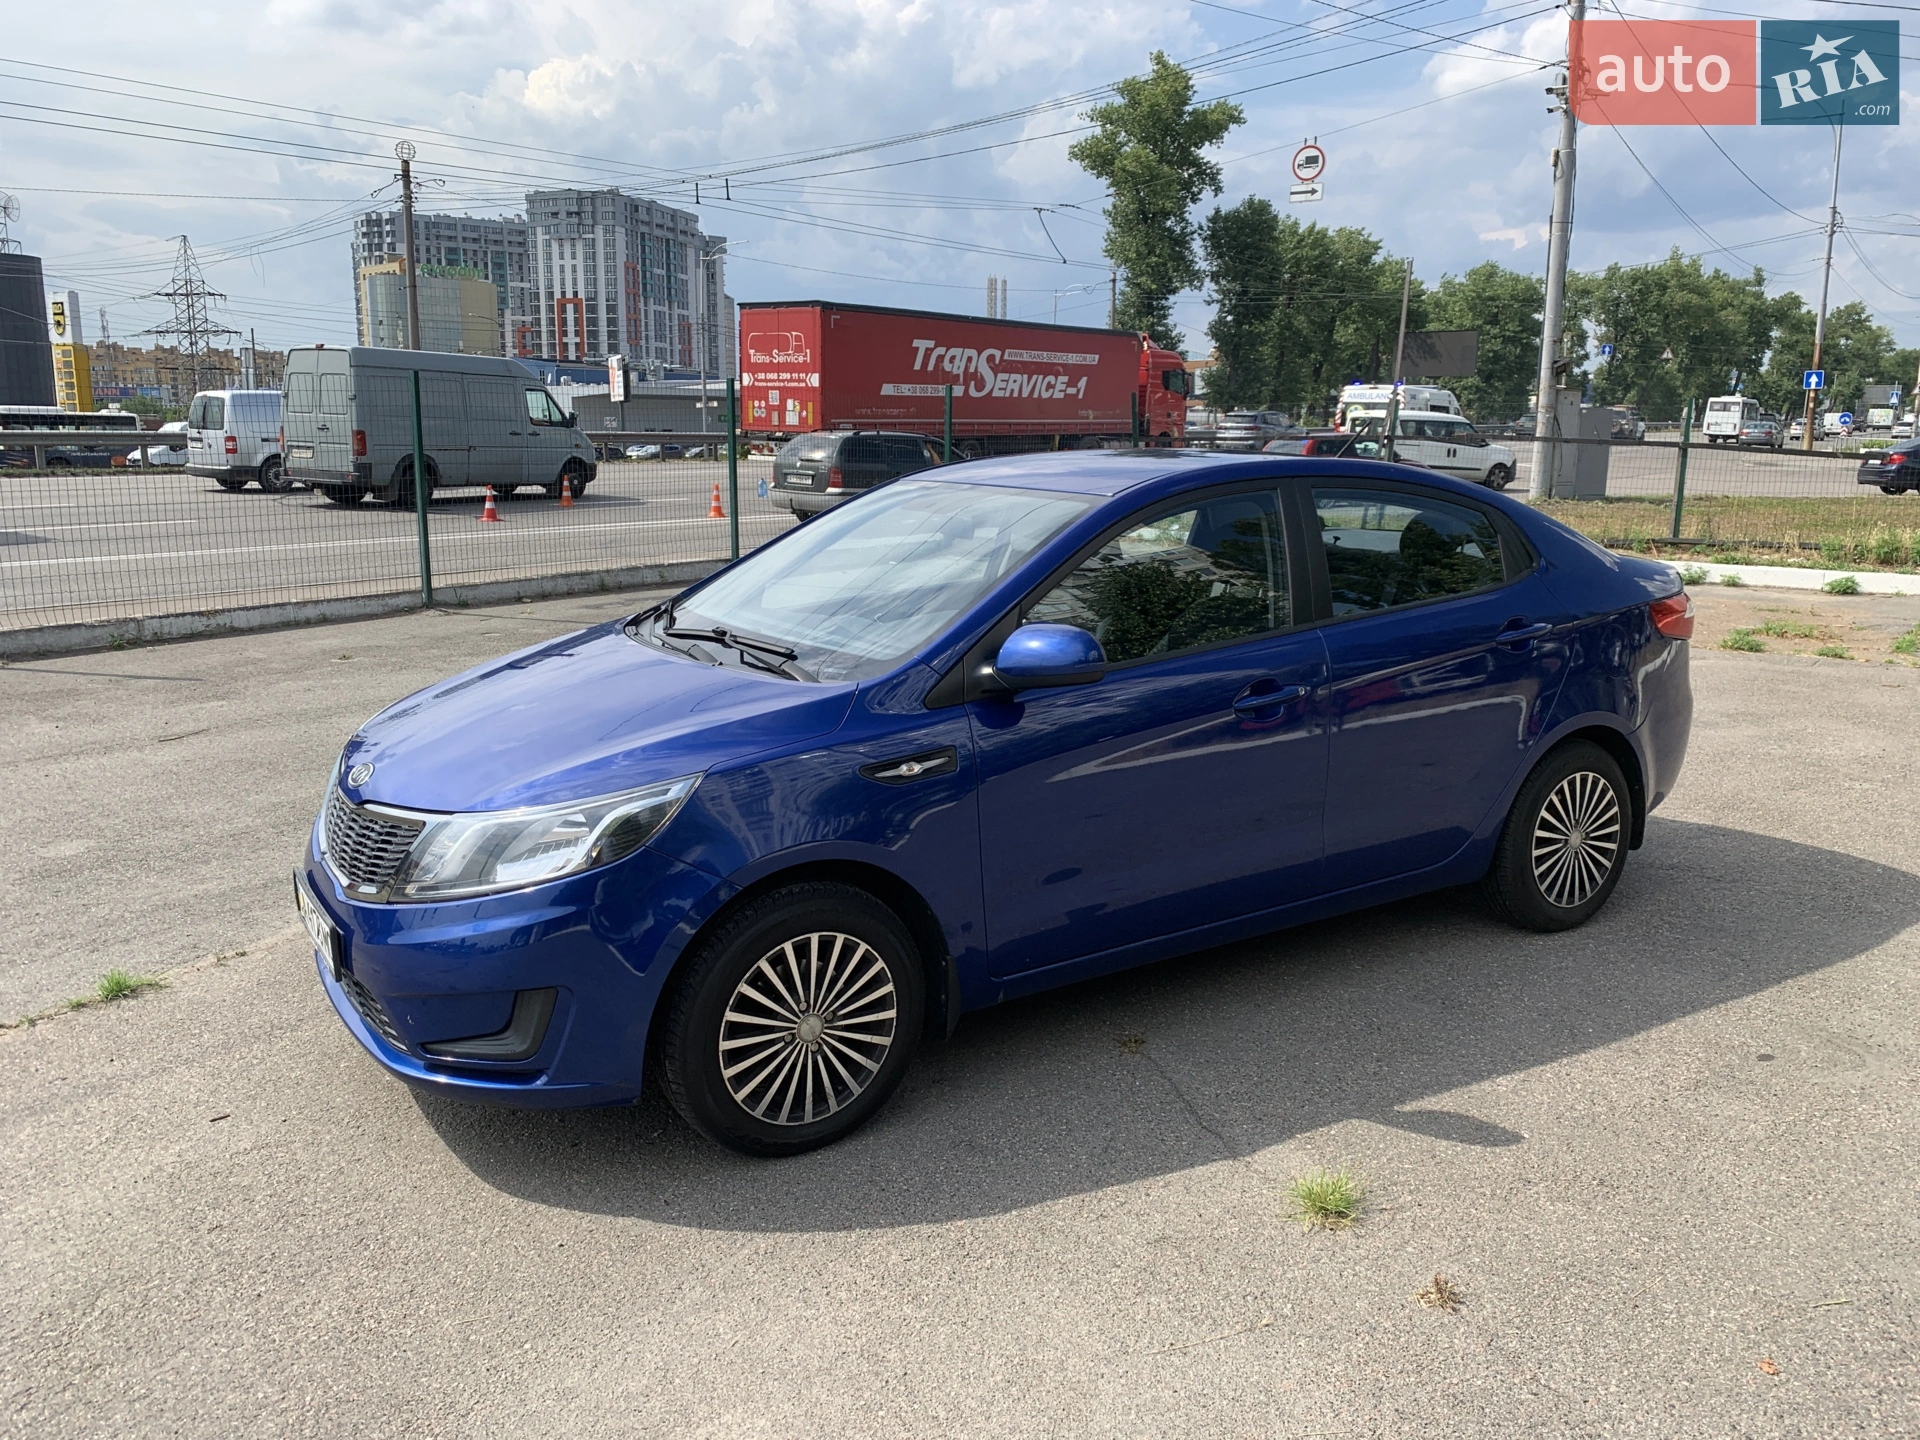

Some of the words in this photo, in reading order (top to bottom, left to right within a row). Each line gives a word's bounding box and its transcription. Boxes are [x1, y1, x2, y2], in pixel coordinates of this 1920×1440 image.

[749, 349, 811, 363] Trans-Service-1
[1007, 350, 1097, 363] WWW.TRANS-SERVICE-1.COM.UA
[754, 372, 766, 380] +38
[766, 372, 778, 380] 068
[778, 372, 791, 380] 299
[892, 384, 907, 394] TEL:
[907, 385, 918, 395] +38
